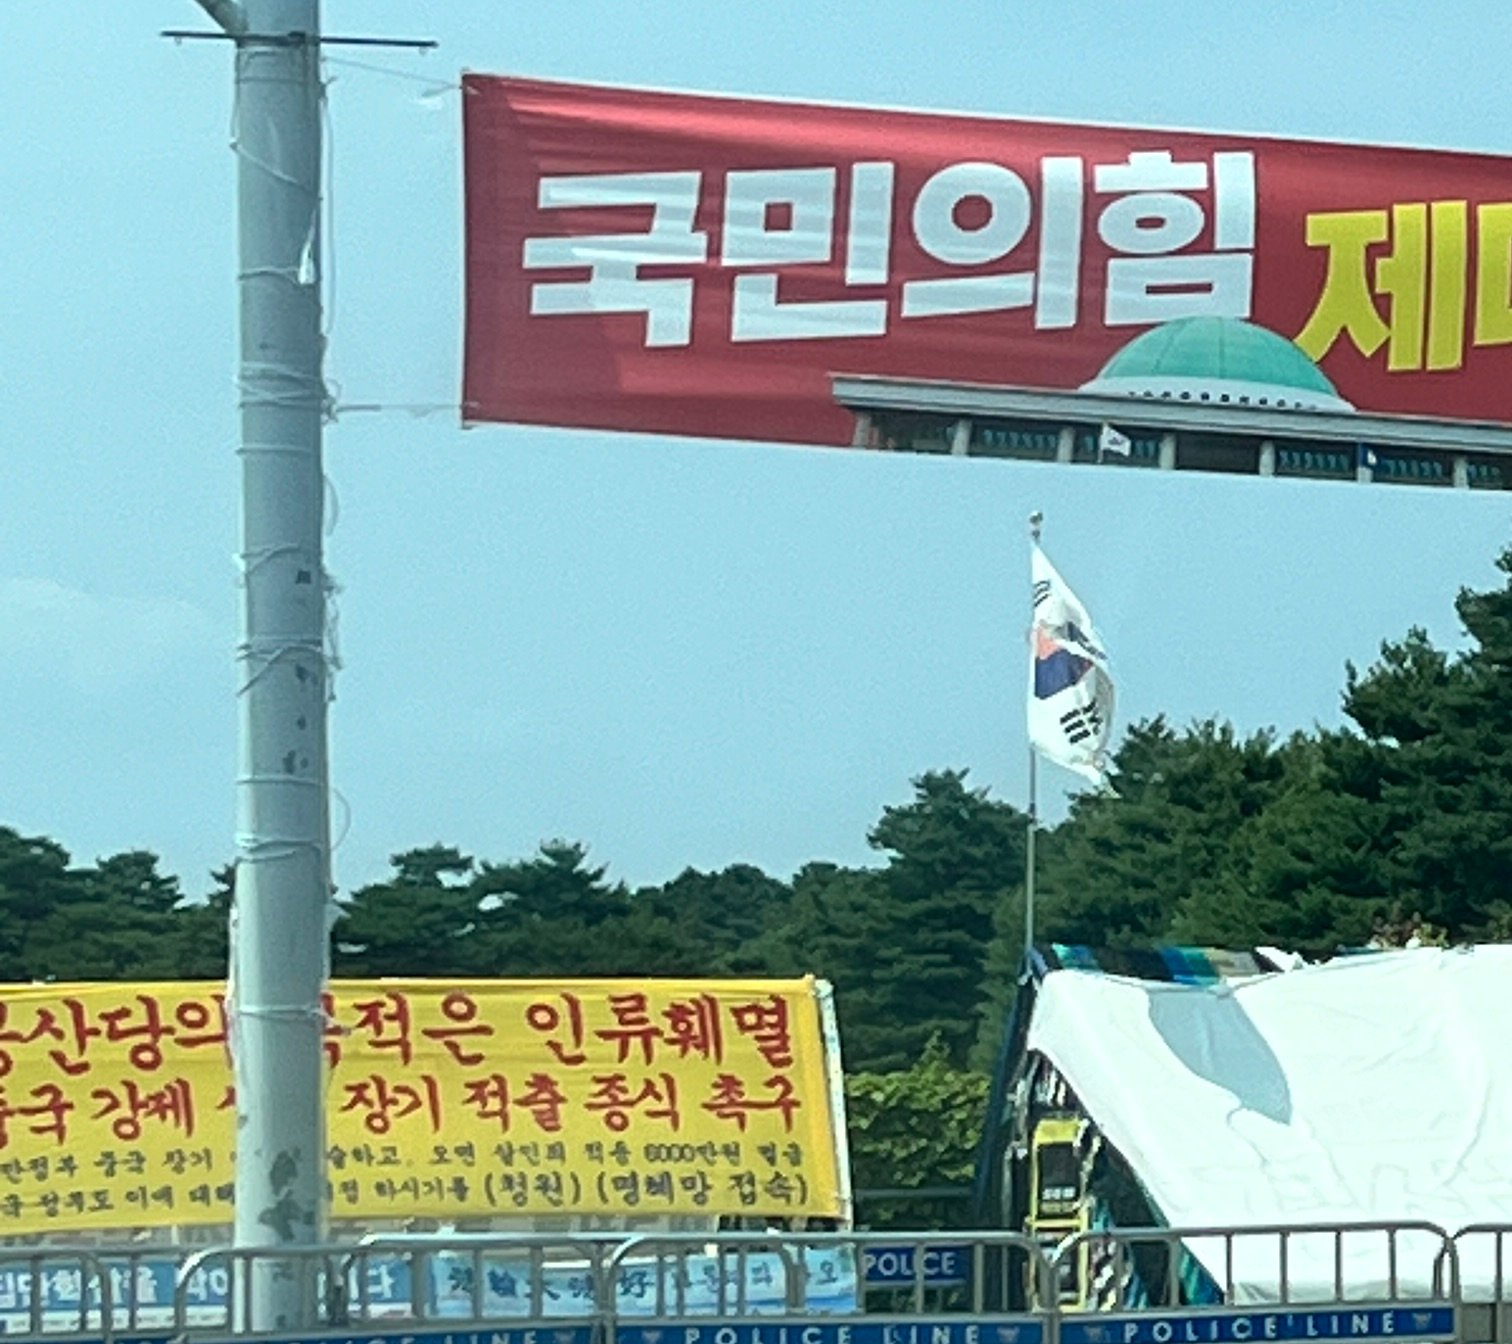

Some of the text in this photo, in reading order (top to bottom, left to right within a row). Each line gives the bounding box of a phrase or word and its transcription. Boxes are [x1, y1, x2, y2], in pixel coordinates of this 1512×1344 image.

[522, 150, 1256, 347] 국민의힘
[91, 1077, 195, 1139] 강제
[338, 1073, 440, 1134] 장기
[462, 1072, 567, 1133] 적출
[585, 1072, 680, 1133] 종식
[702, 1073, 801, 1133] 촉구
[862, 1251, 956, 1276] POLCE
[1123, 1310, 1396, 1344] POLICE LINE
